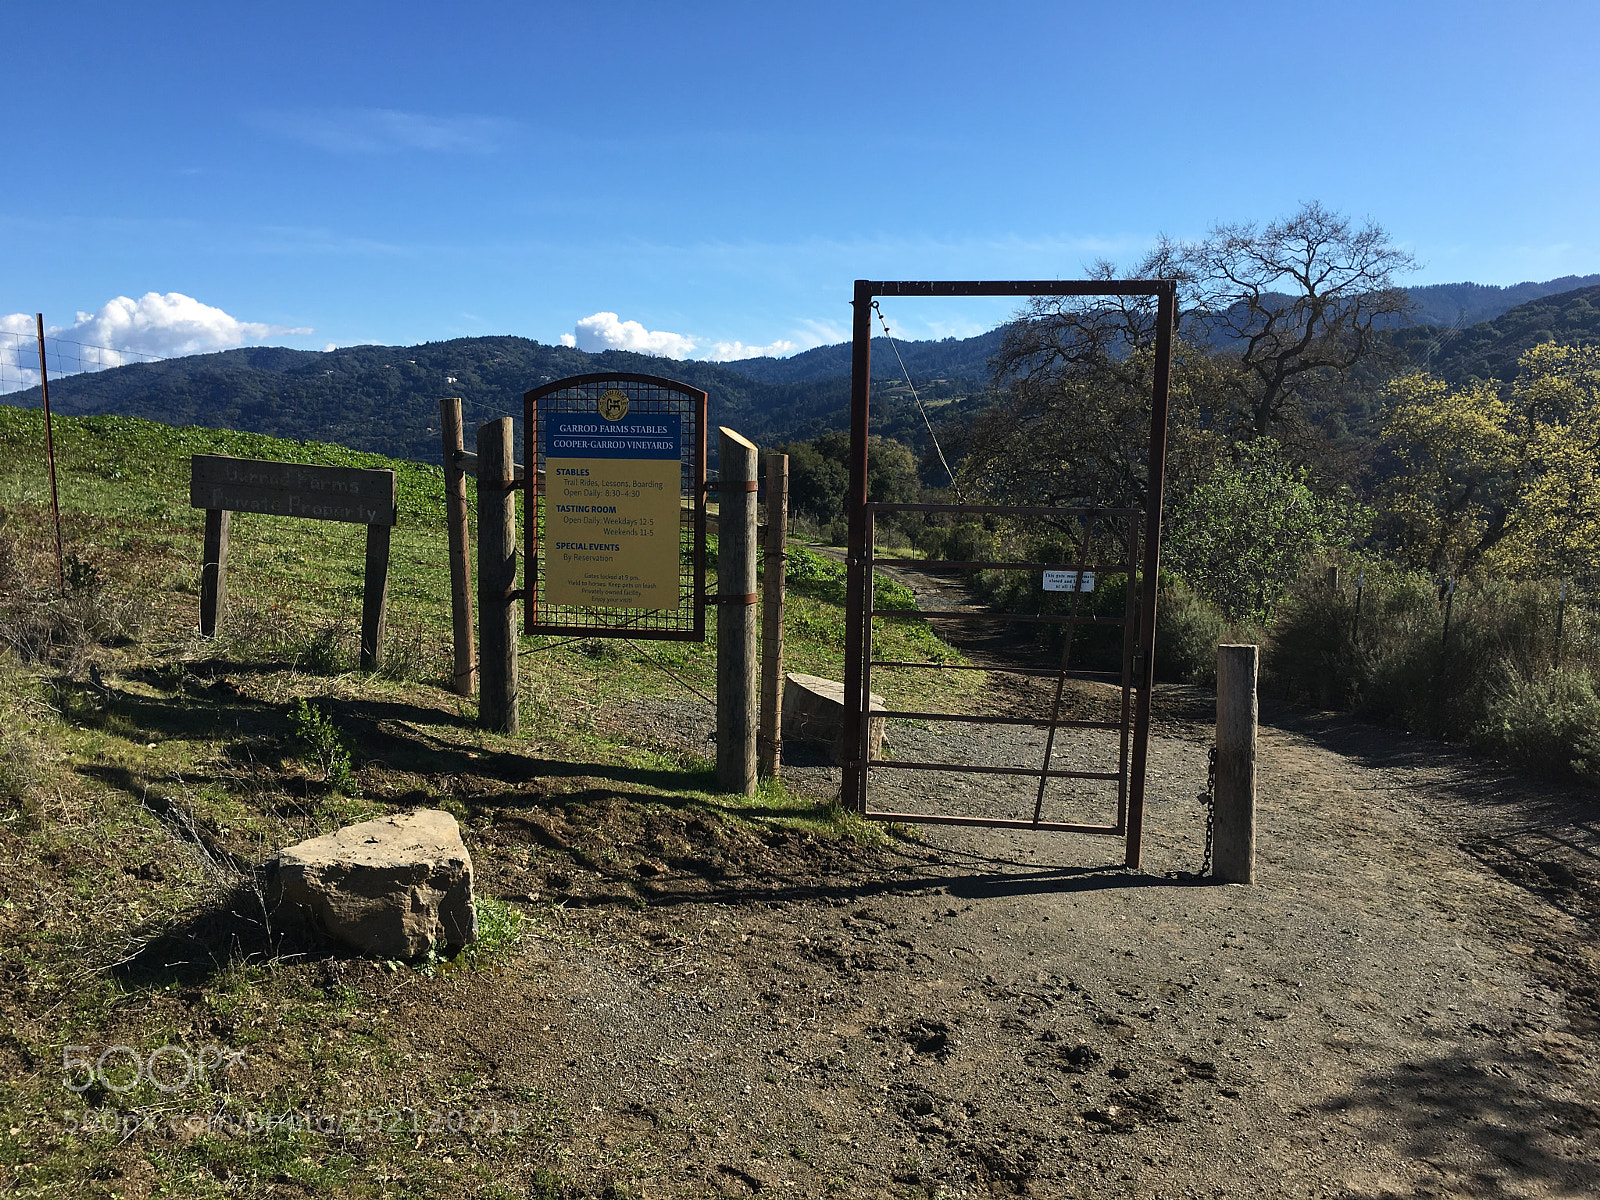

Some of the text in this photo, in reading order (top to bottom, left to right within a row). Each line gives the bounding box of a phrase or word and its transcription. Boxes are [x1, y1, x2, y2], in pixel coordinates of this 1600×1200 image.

[559, 424, 668, 434] GARROD FARMS STABLES
[553, 440, 674, 450] COOPER-GARROD VINEYARDS
[556, 468, 590, 476] STABLES
[563, 478, 663, 490] Trail Rides, Lessons, Boarding
[563, 488, 582, 498] Open
[583, 488, 603, 499] Daily:
[287, 494, 377, 523] Property
[556, 504, 617, 514] TASTING ROOM
[563, 516, 582, 525] Open
[603, 517, 638, 528] Weekdays
[640, 518, 654, 526] 12-5
[603, 528, 654, 537] Weekends 11-5
[555, 542, 620, 552] SPECIAL EVENTS
[563, 553, 614, 563] By Reservation
